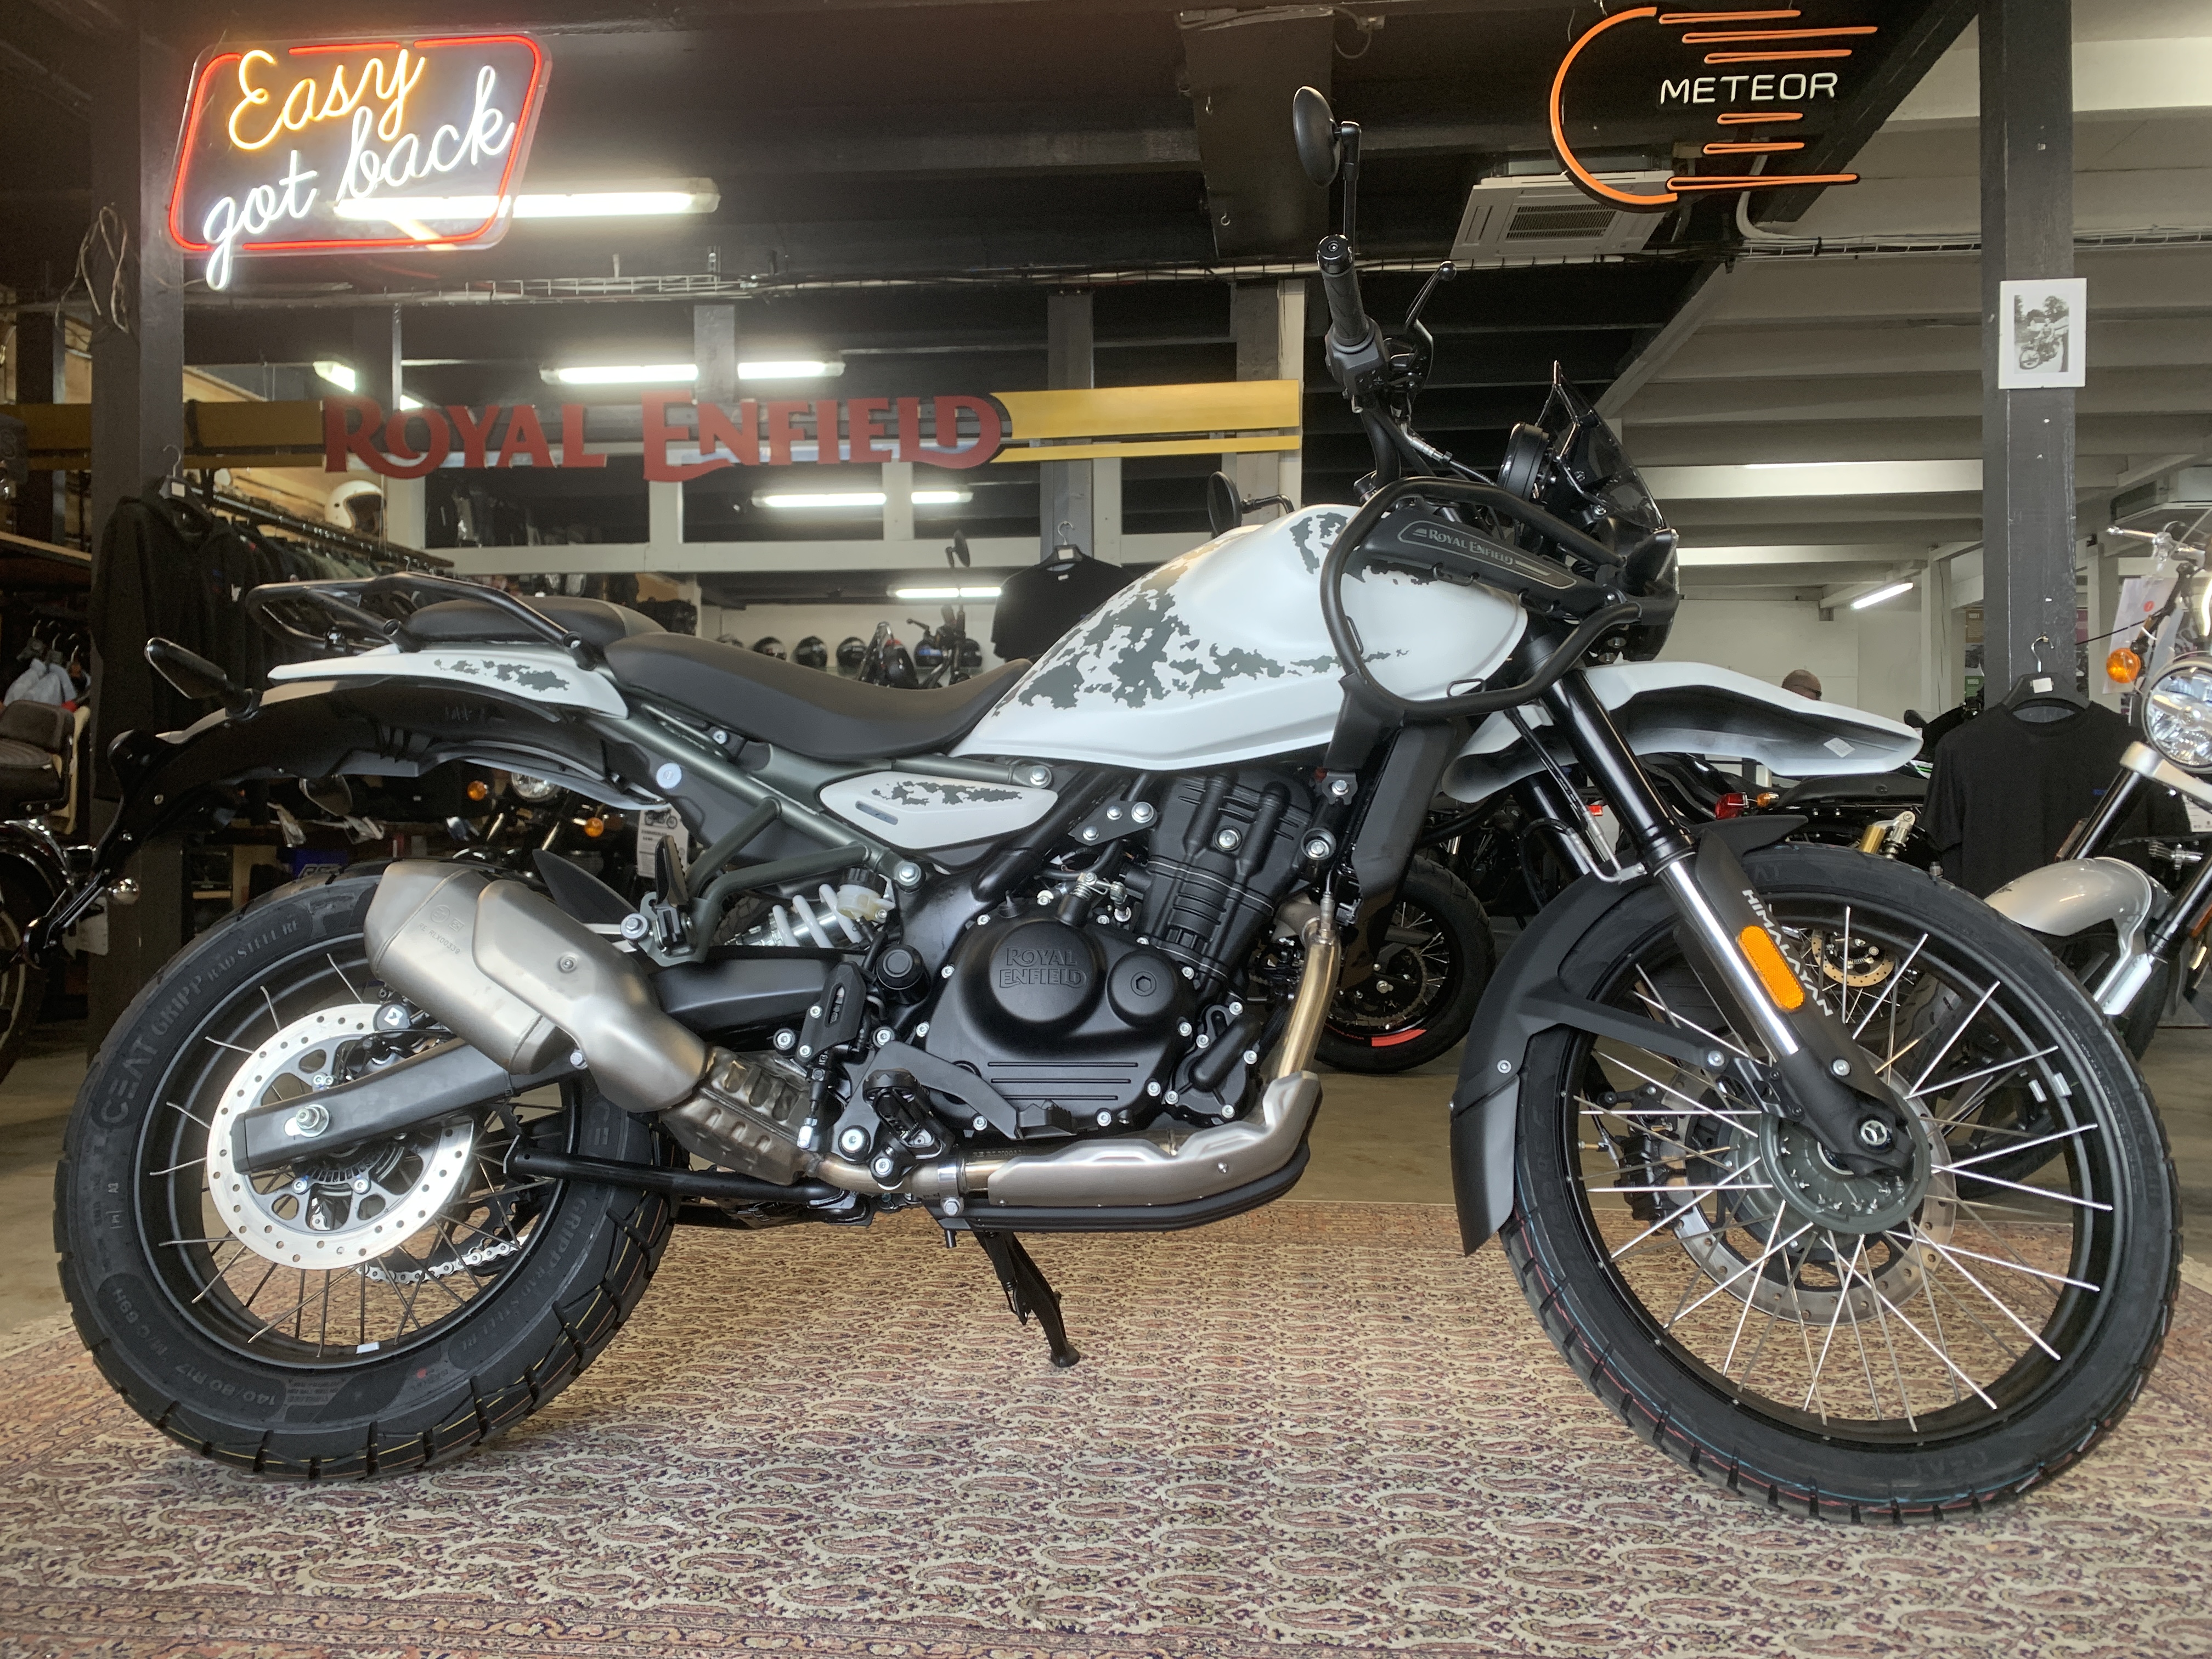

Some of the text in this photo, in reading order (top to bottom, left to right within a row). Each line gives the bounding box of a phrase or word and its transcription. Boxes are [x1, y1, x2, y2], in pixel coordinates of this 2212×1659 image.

[227, 48, 427, 150] Easy
[1660, 72, 1839, 105] METEOR
[202, 65, 516, 291] got back
[323, 390, 1001, 482] ROYAL ENFIELD
[1427, 528, 1514, 566] ROYAL ENFIELD
[999, 947, 1087, 989] ROYAL ENFIELD
[1742, 889, 1834, 1017] HIMALAYAN
[101, 1033, 159, 1124] CEAT
[209, 1379, 276, 1406] 140/80
